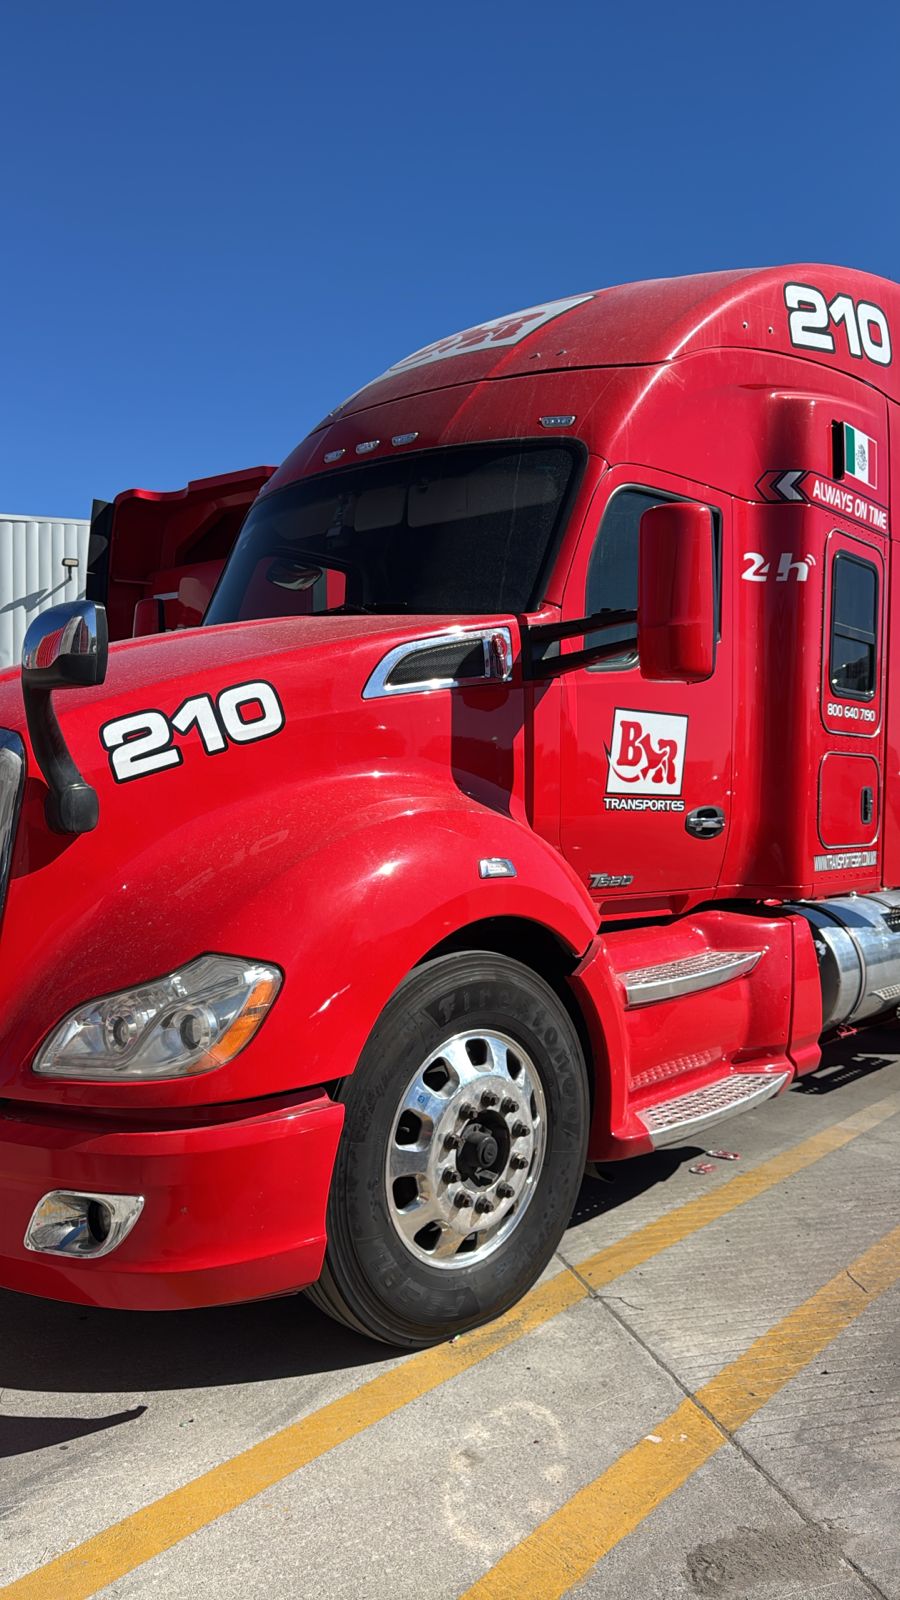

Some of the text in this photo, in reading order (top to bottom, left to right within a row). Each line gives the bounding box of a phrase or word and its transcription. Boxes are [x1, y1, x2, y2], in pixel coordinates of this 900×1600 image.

[783, 281, 892, 368] 210
[812, 479, 888, 530] ALWAYS ON TIME
[827, 702, 843, 717] 800
[844, 705, 859, 720] 640
[99, 679, 286, 784] 210
[603, 797, 685, 813] TRANSPORTES
[589, 872, 634, 888] T680
